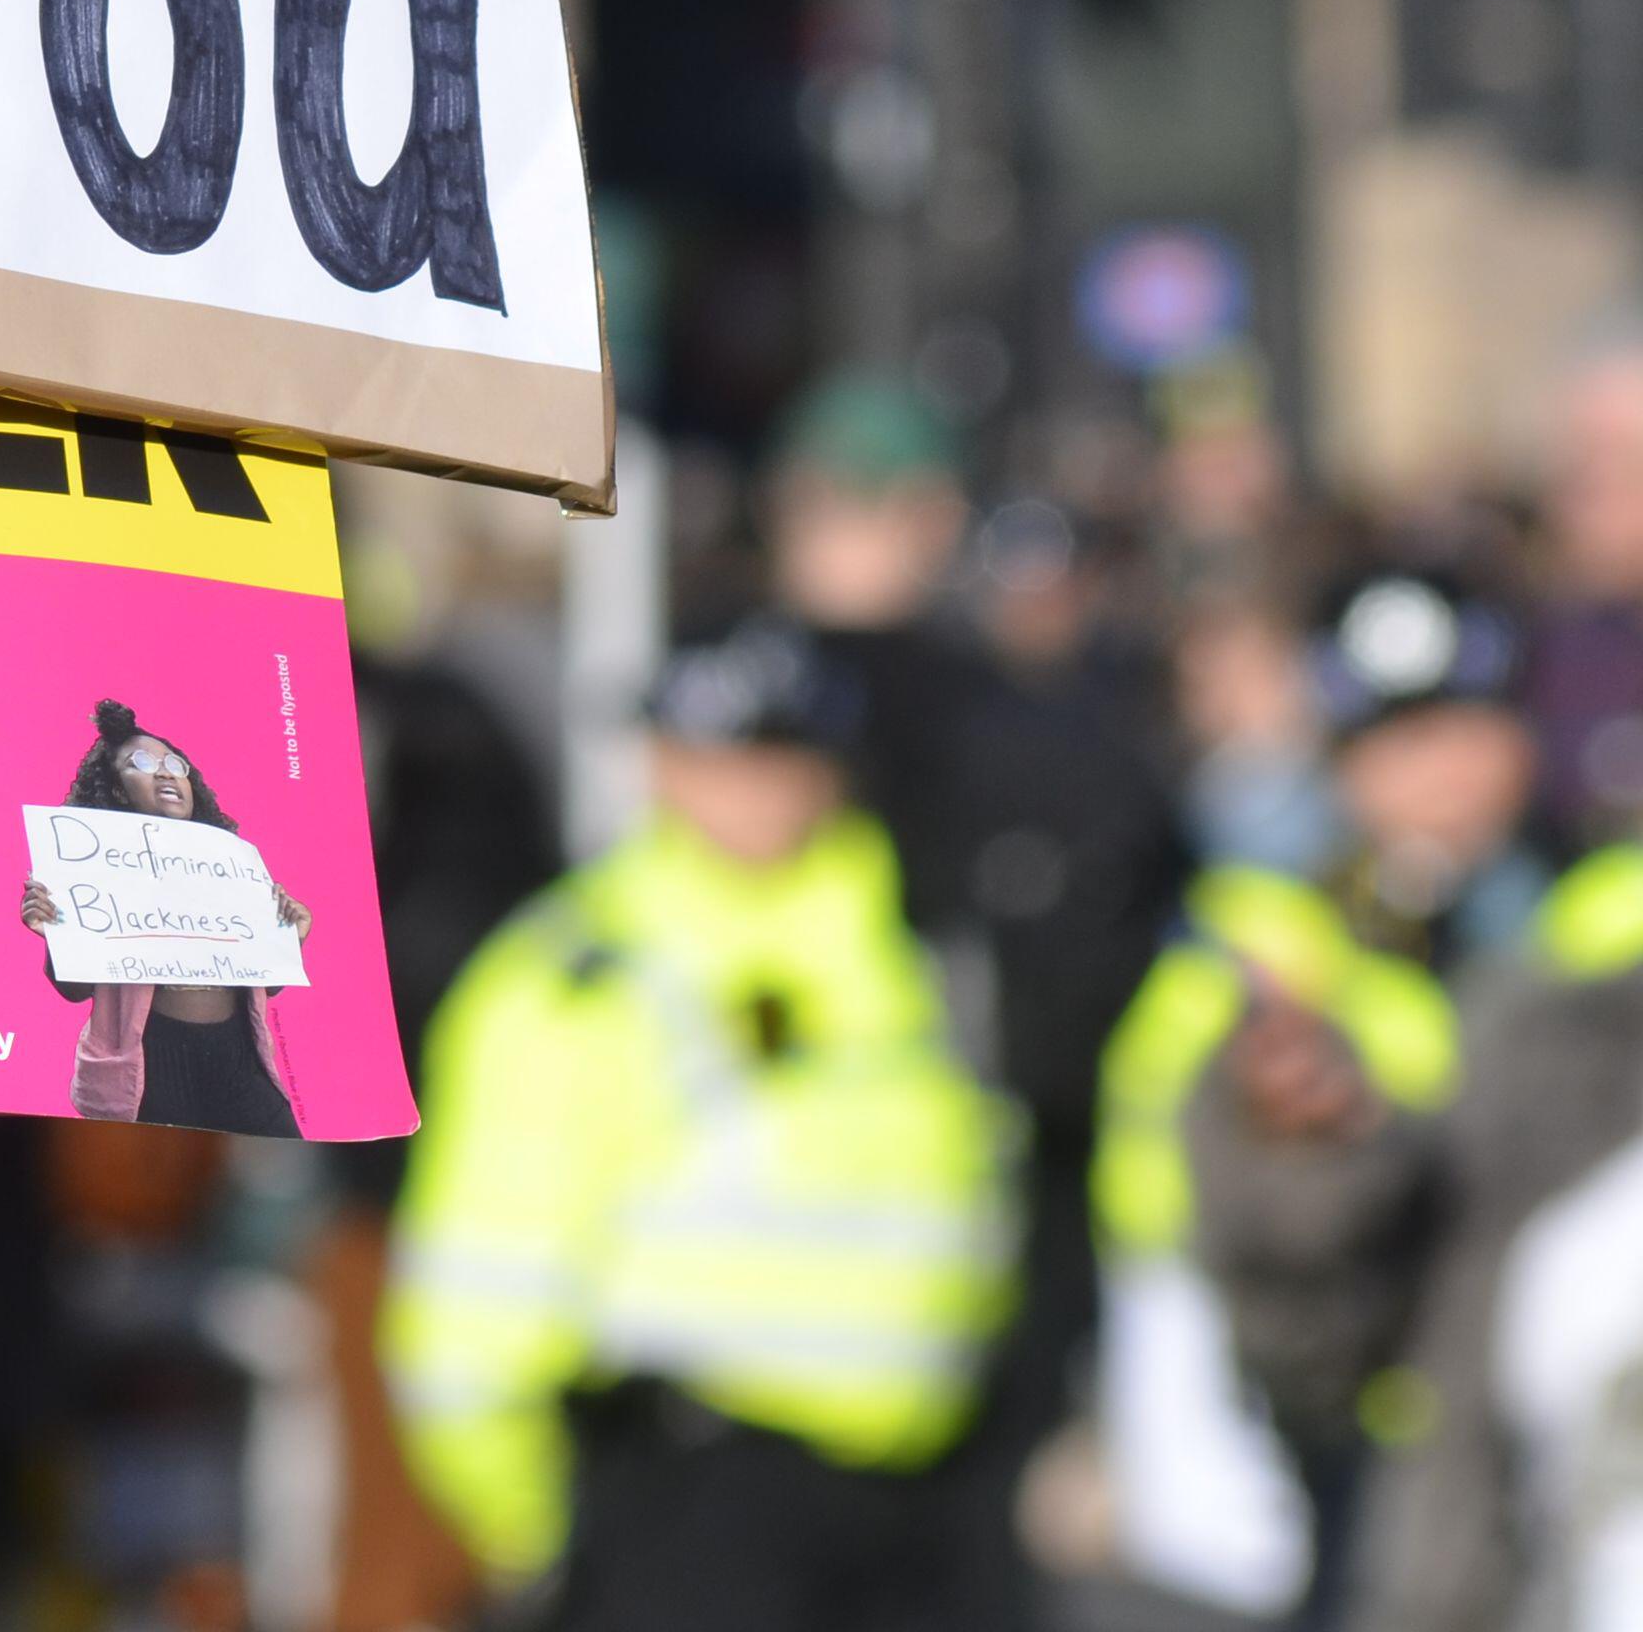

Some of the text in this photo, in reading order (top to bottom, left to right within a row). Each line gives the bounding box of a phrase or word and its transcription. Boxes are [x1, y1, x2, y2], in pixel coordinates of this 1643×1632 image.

[273, 653, 301, 780] Not to be flyposted
[68, 883, 254, 940] Blackness
